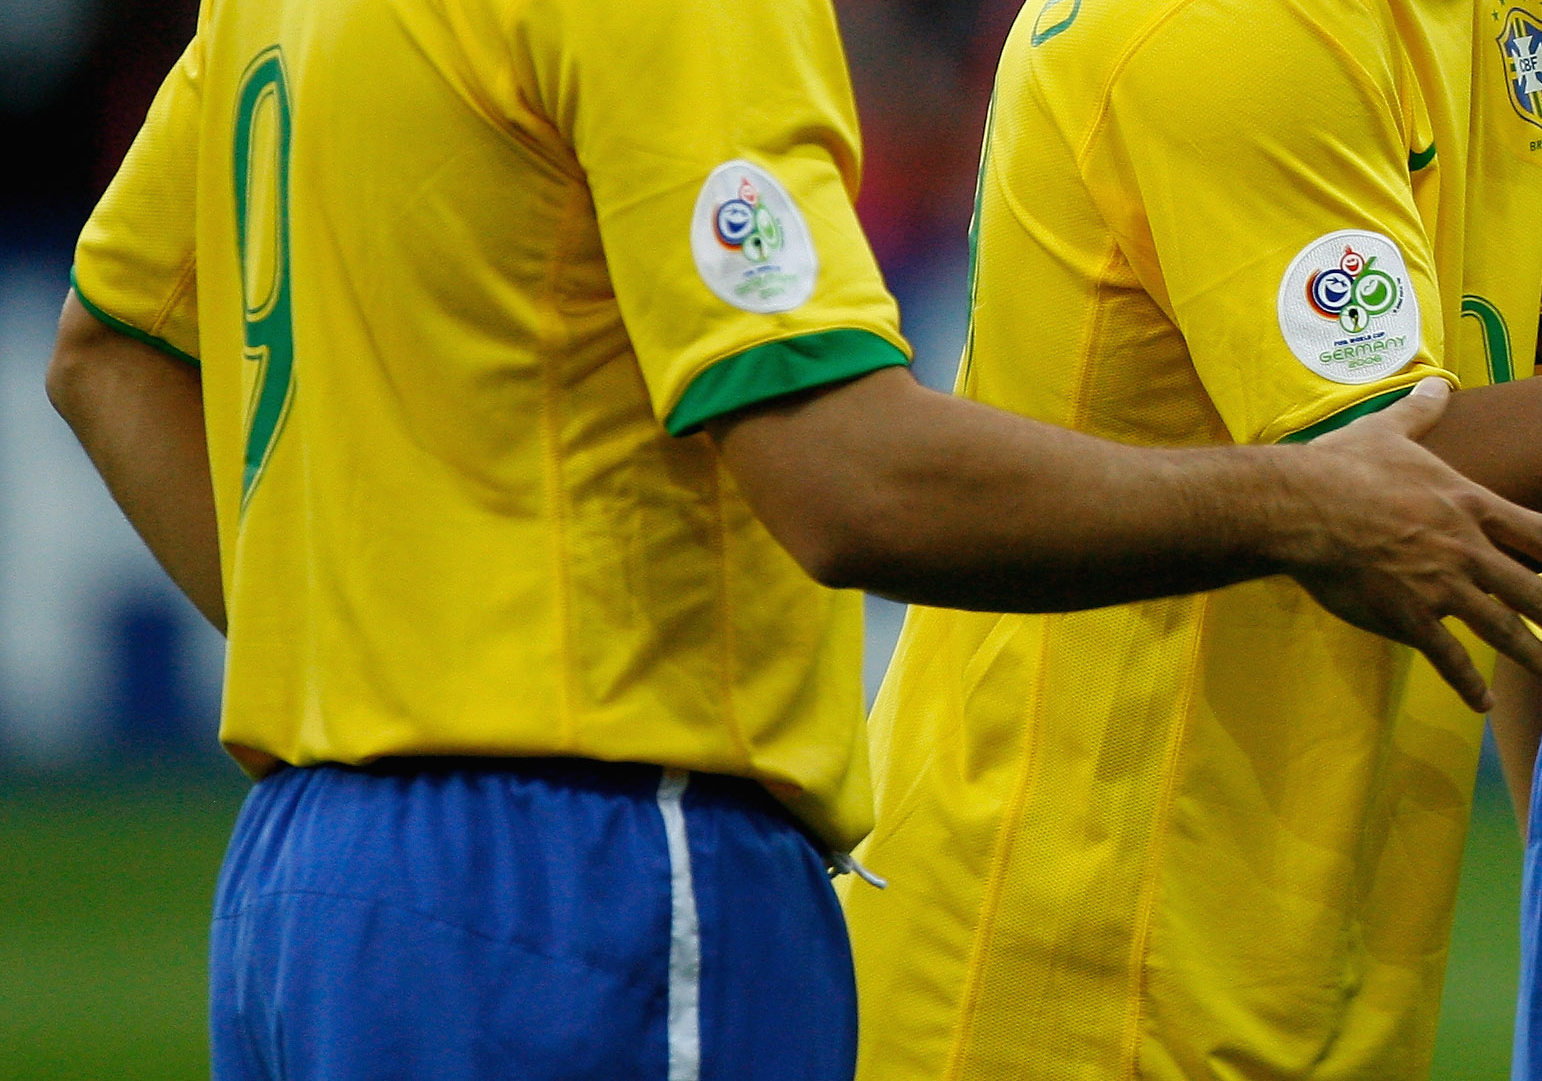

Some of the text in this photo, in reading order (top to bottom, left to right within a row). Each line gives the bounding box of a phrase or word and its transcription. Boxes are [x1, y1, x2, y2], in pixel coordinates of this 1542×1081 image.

[1518, 55, 1539, 73] CBF
[233, 44, 294, 515] 9
[1319, 335, 1407, 363] GERMANY
[1348, 355, 1383, 369] 2006
